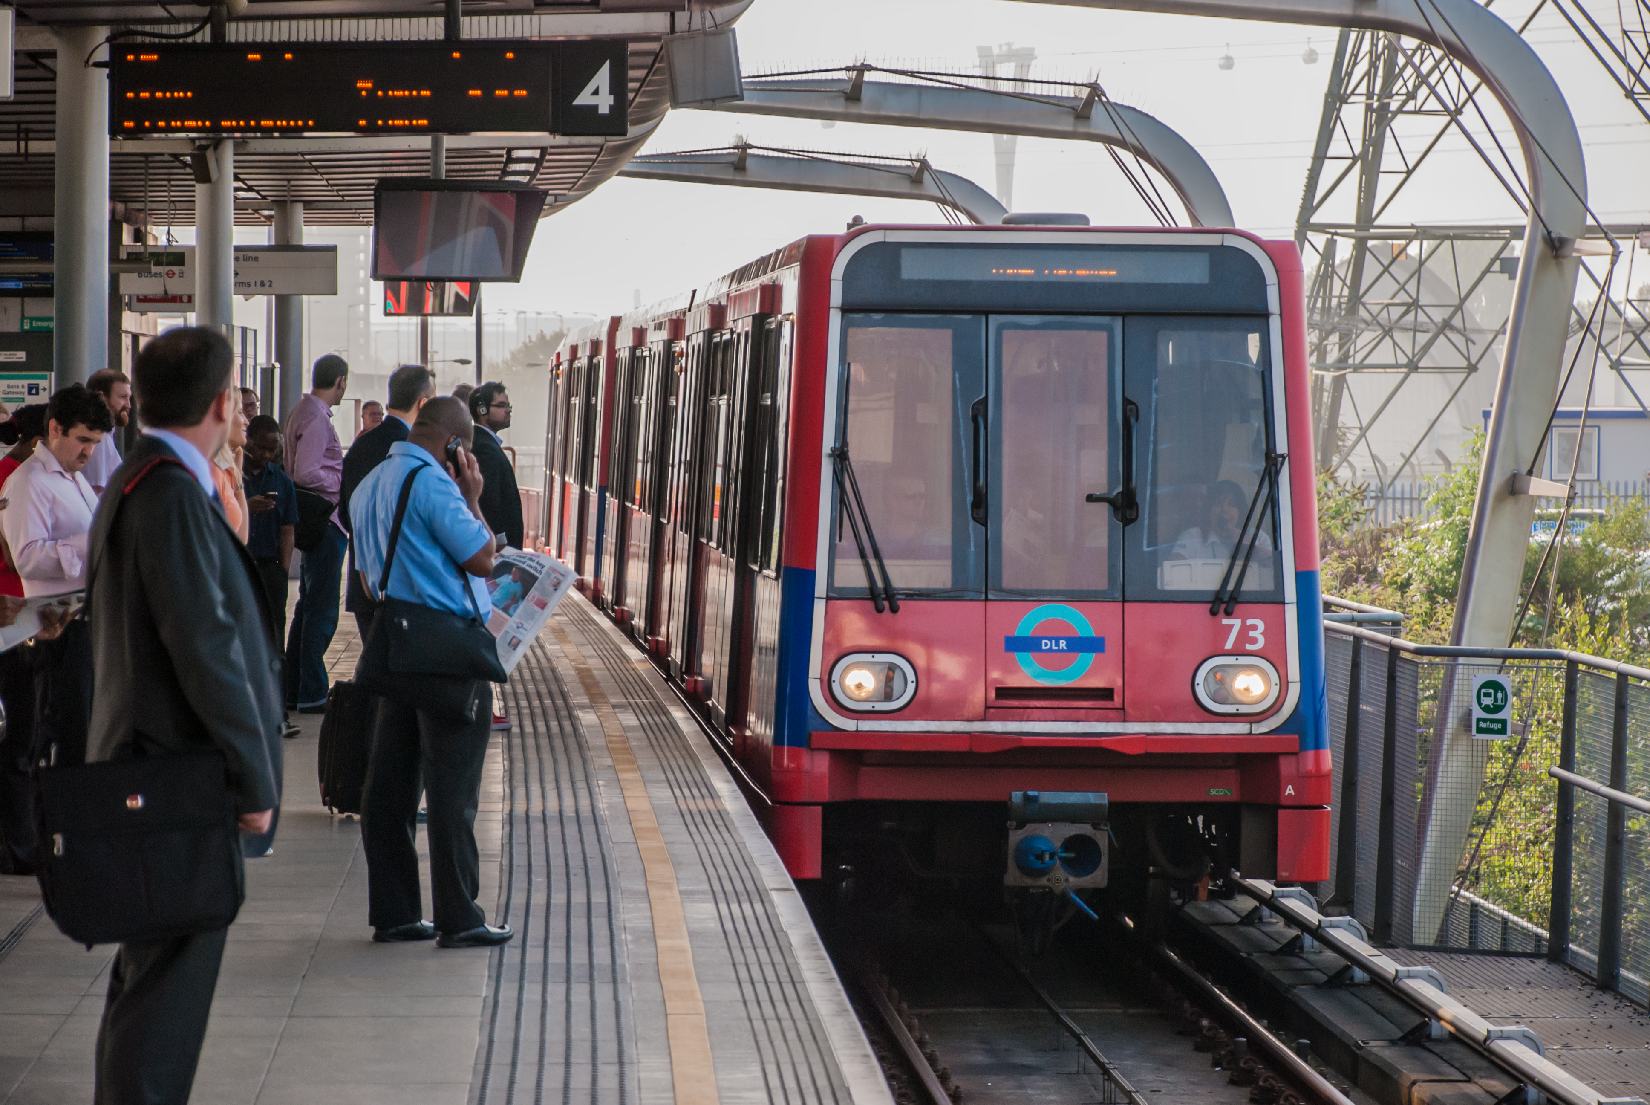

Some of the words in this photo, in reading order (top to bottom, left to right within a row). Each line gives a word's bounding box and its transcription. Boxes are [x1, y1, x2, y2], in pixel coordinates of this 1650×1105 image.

[572, 59, 616, 114] 4
[242, 253, 259, 262] line
[259, 280, 266, 288] &
[267, 280, 273, 288] 2
[1221, 618, 1266, 651] 73
[1041, 639, 1068, 650] DLR
[1478, 721, 1502, 730] Refuge
[1284, 784, 1295, 796] A
